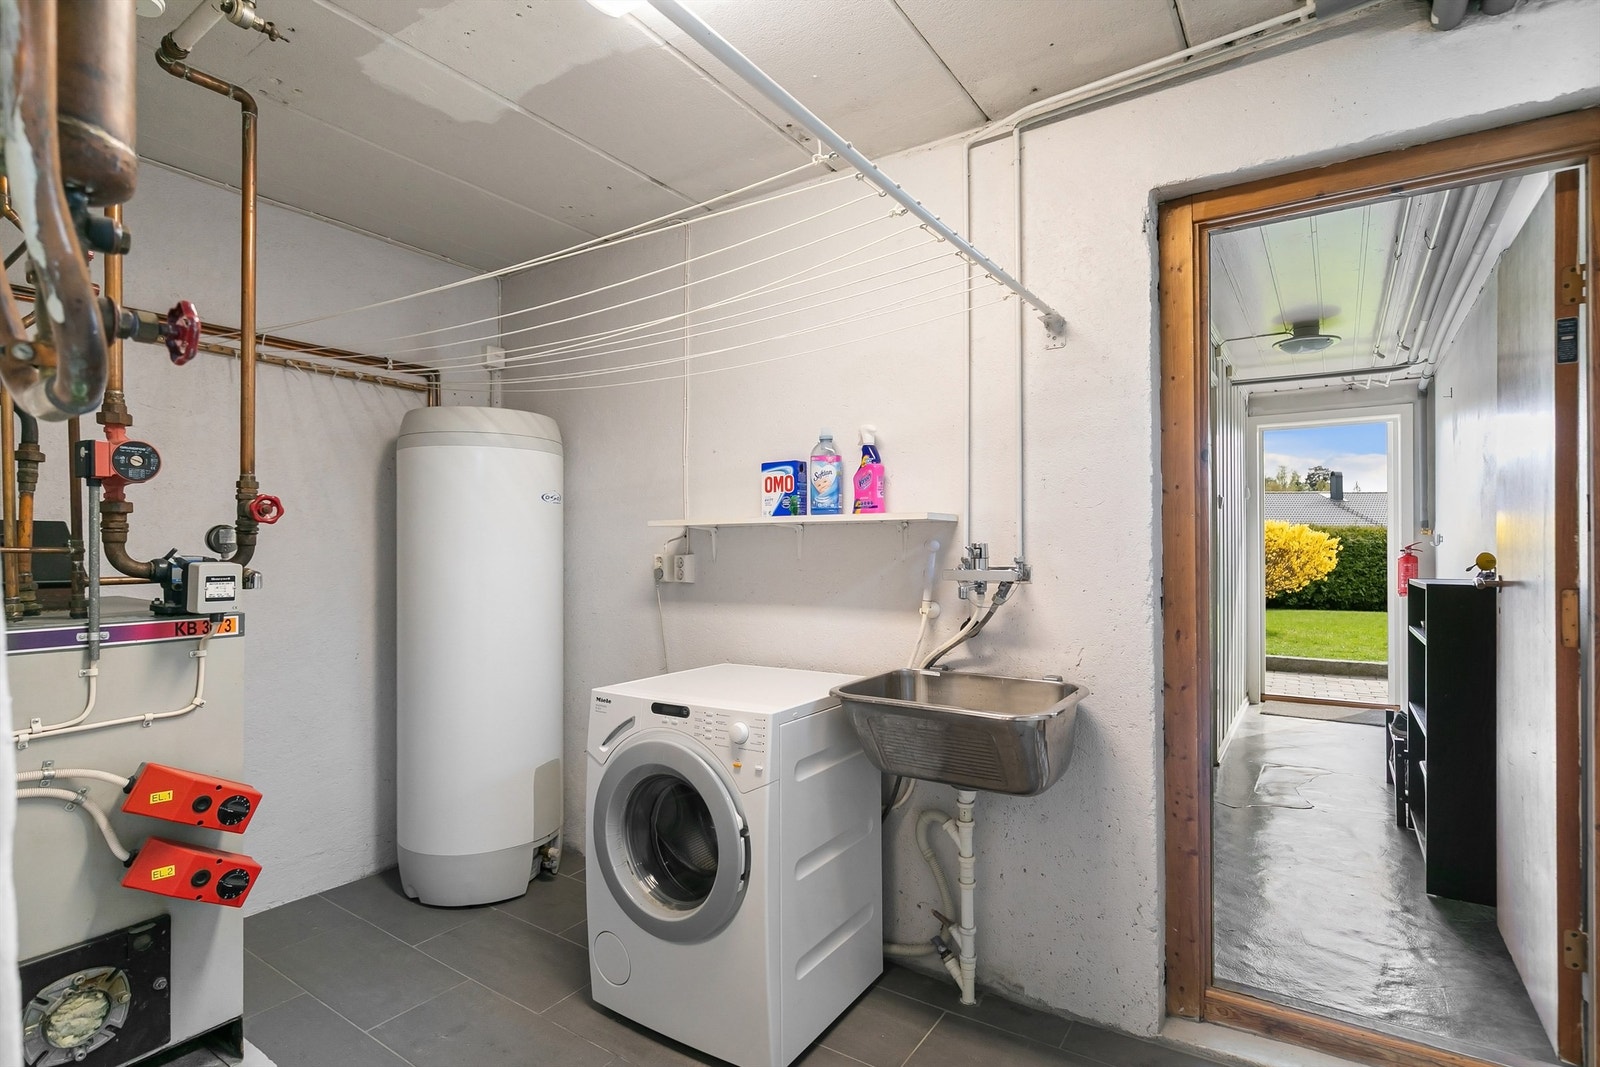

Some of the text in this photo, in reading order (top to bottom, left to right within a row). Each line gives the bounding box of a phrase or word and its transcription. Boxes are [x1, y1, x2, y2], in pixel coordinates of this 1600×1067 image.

[813, 469, 833, 482] Softlan
[764, 474, 794, 494] OMO
[175, 620, 197, 637] KB
[595, 696, 612, 704] Miele
[151, 791, 172, 803] EL.1
[152, 867, 174, 880] EL.2
